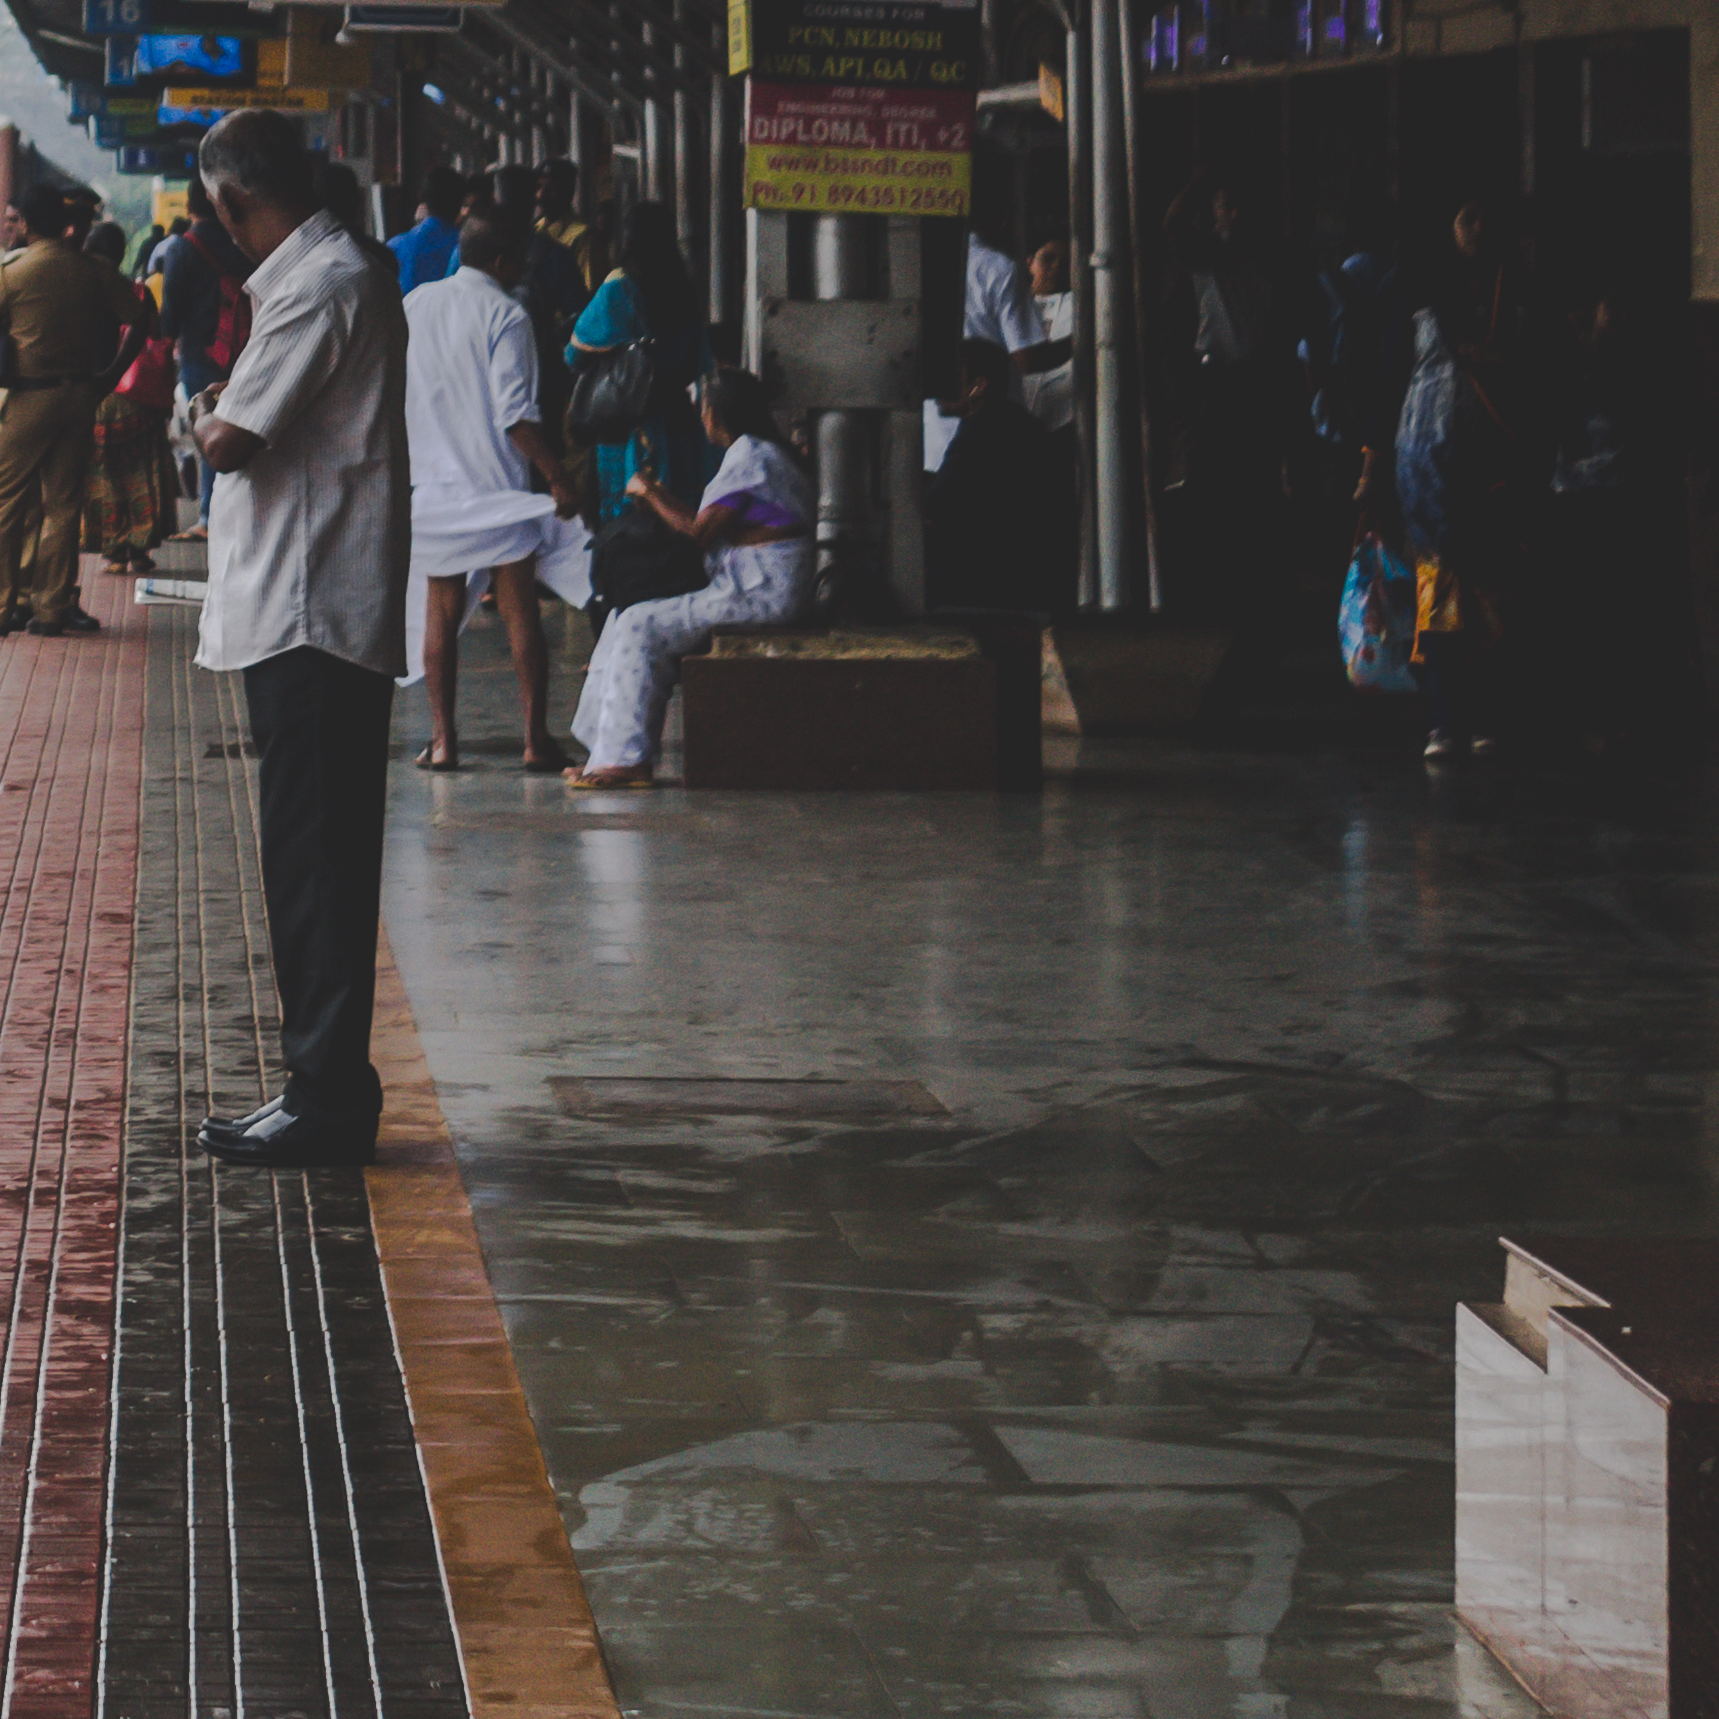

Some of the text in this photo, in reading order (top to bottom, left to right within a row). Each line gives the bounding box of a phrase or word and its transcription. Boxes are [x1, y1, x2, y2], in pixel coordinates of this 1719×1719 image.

[803, 4, 926, 21] COURSES FOR
[930, 59, 966, 84] QC
[753, 116, 966, 150] DIPLOMA, ITI, +2
[767, 153, 953, 178] www.bssndt.com
[793, 181, 816, 203] 91
